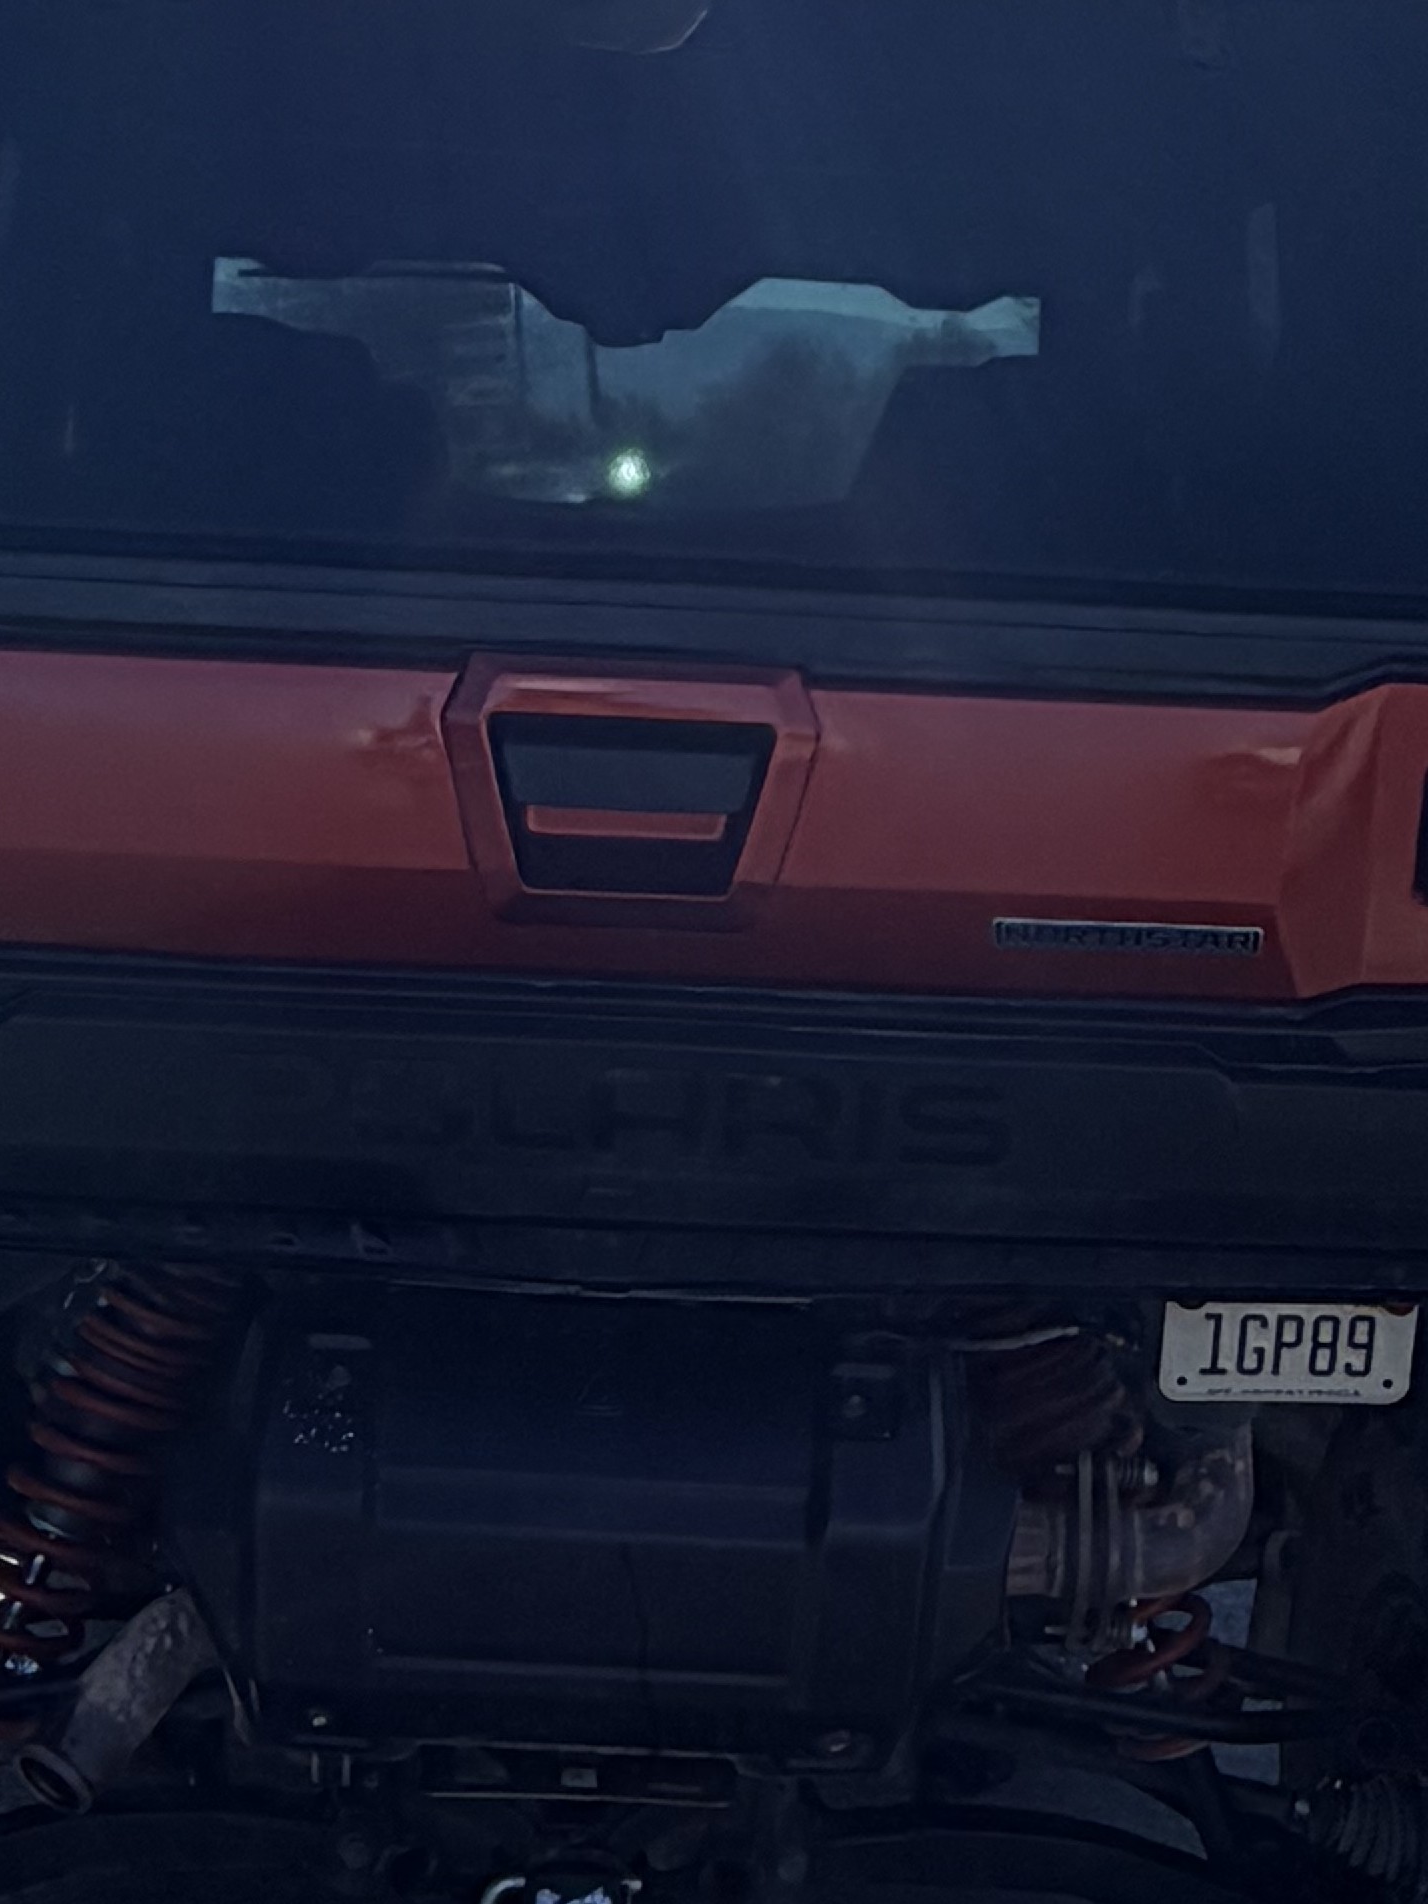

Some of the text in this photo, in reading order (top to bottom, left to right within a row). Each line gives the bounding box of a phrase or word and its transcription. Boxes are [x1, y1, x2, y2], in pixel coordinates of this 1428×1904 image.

[1003, 923, 1250, 950] NORTHSTAR
[227, 1051, 1011, 1163] POLARIS
[1198, 1312, 1377, 1377] 1GP89
